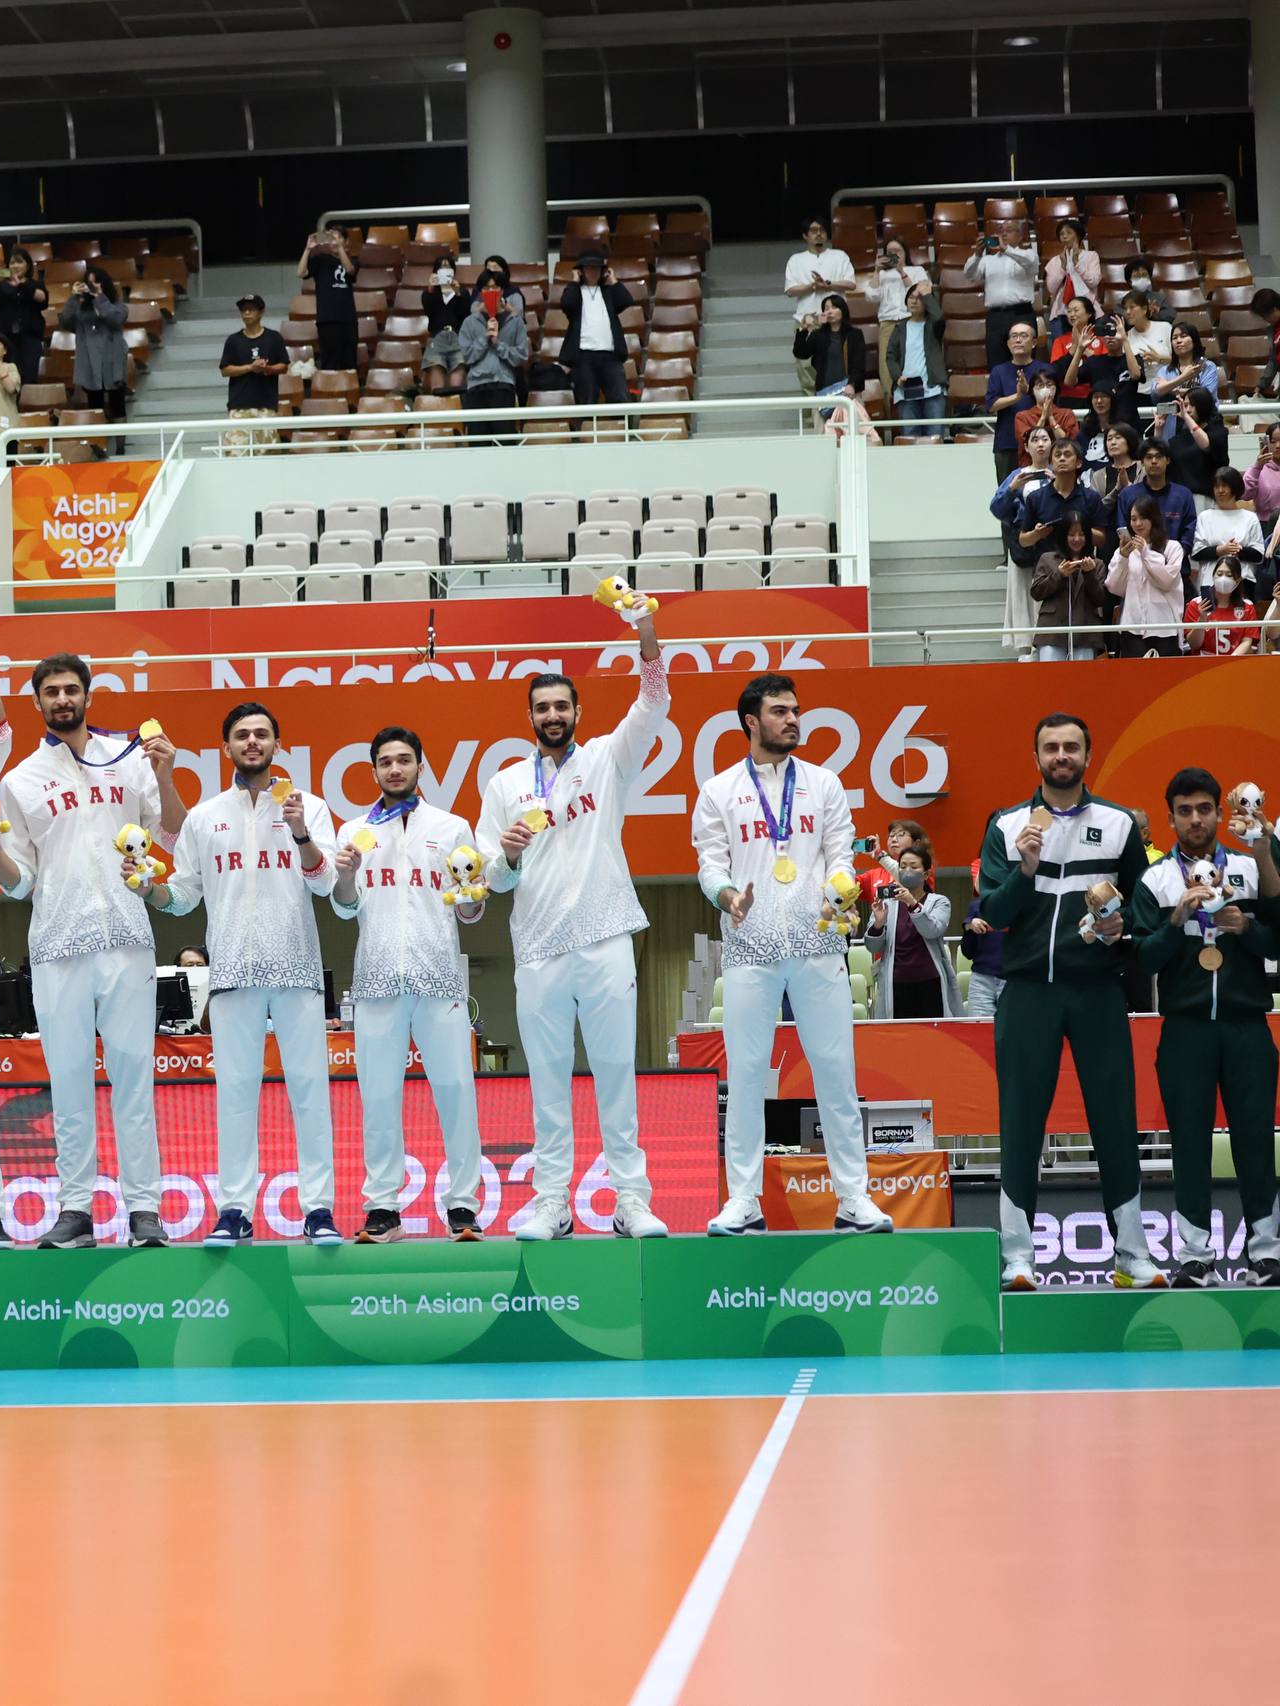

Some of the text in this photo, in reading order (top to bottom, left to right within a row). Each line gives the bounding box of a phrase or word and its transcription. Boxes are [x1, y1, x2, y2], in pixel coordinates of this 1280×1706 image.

[53, 491, 129, 518] Aichi-
[60, 546, 122, 570] 2026
[1218, 629, 1231, 654] 5
[43, 780, 60, 793] I.R.
[47, 786, 124, 818] IRAN
[738, 795, 756, 805] I.R.
[542, 793, 597, 834] RAN
[214, 822, 231, 833] I.R.
[739, 815, 815, 843] IRN
[214, 850, 292, 874] IRAN
[365, 867, 443, 891] IRAN
[874, 1128, 913, 1137] BORNAN
[350, 1293, 580, 1316] 20th Asian Games
[706, 1285, 940, 1313] Aichi-Nagoya 2026
[3, 1298, 230, 1325] Aichi-Nagoya 2026
